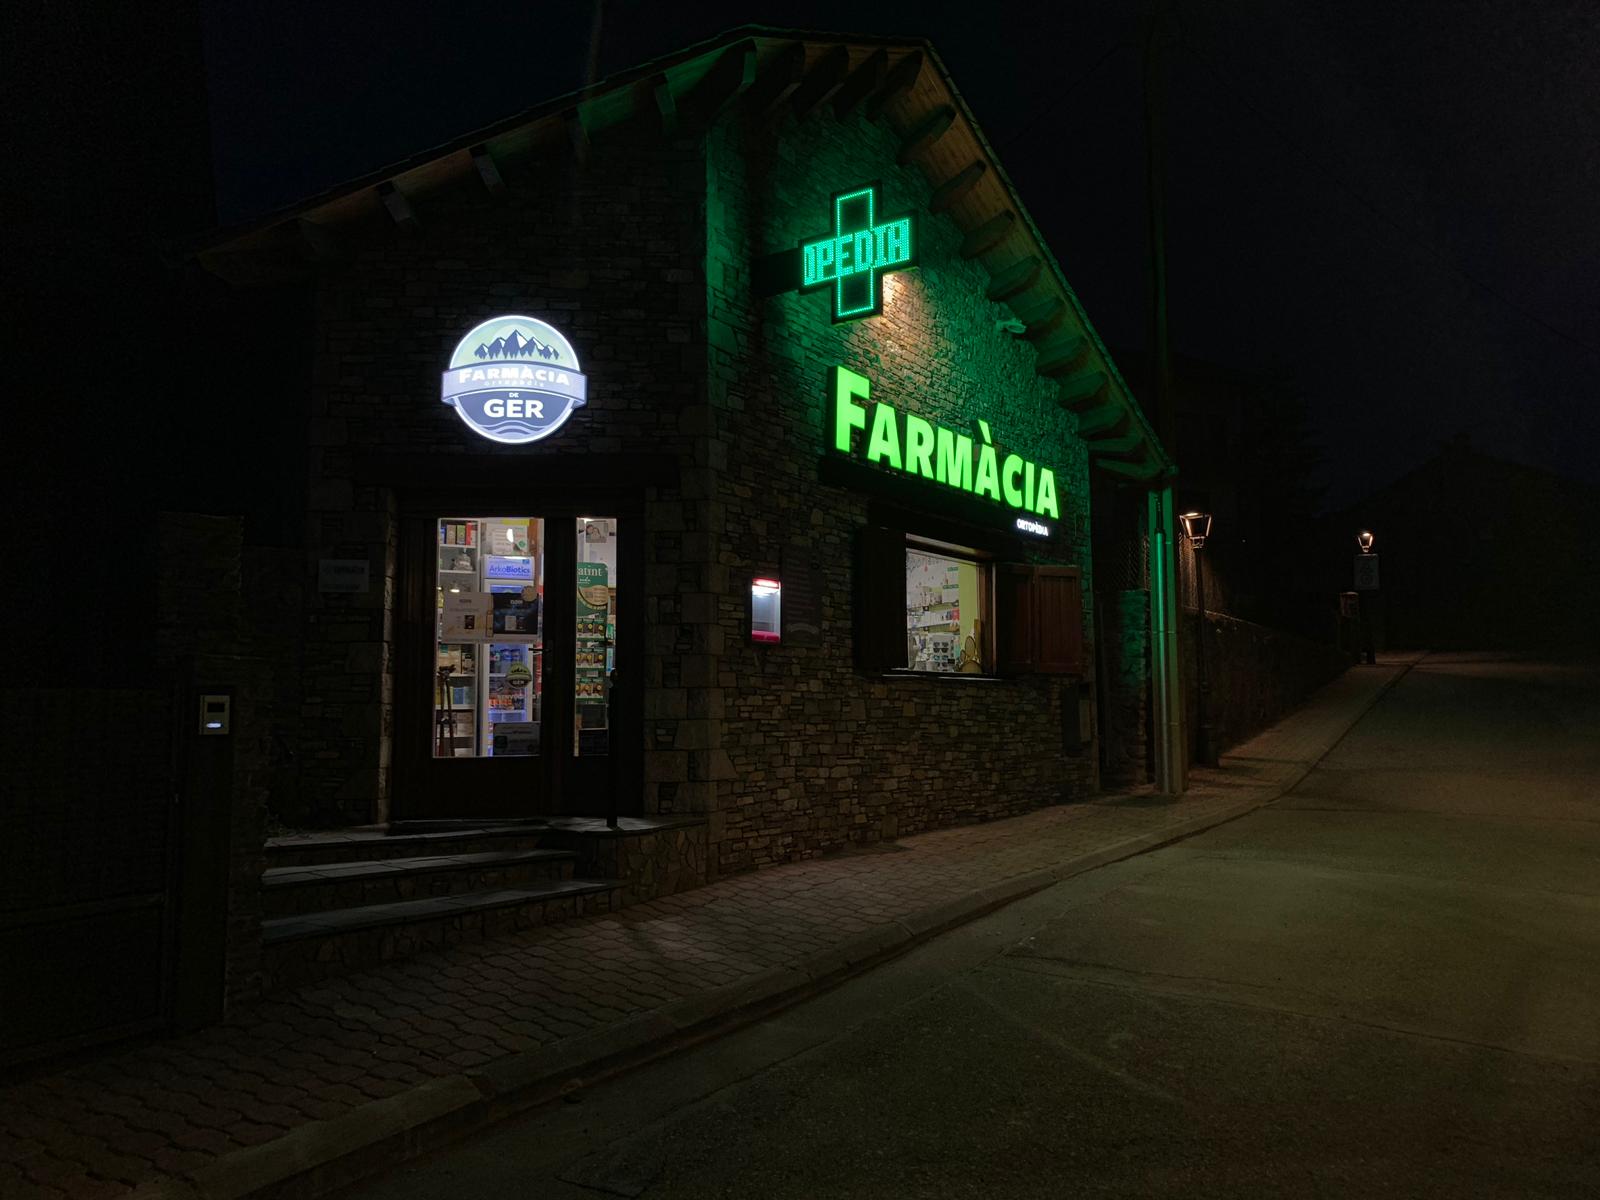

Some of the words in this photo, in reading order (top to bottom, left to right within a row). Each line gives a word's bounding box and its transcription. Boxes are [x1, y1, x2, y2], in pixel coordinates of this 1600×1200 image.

[458, 366, 570, 386] FARMÀCIA
[483, 399, 544, 418] GER
[834, 365, 1060, 519] FARMÀCIA
[489, 565, 530, 575] ArkoBiotics
